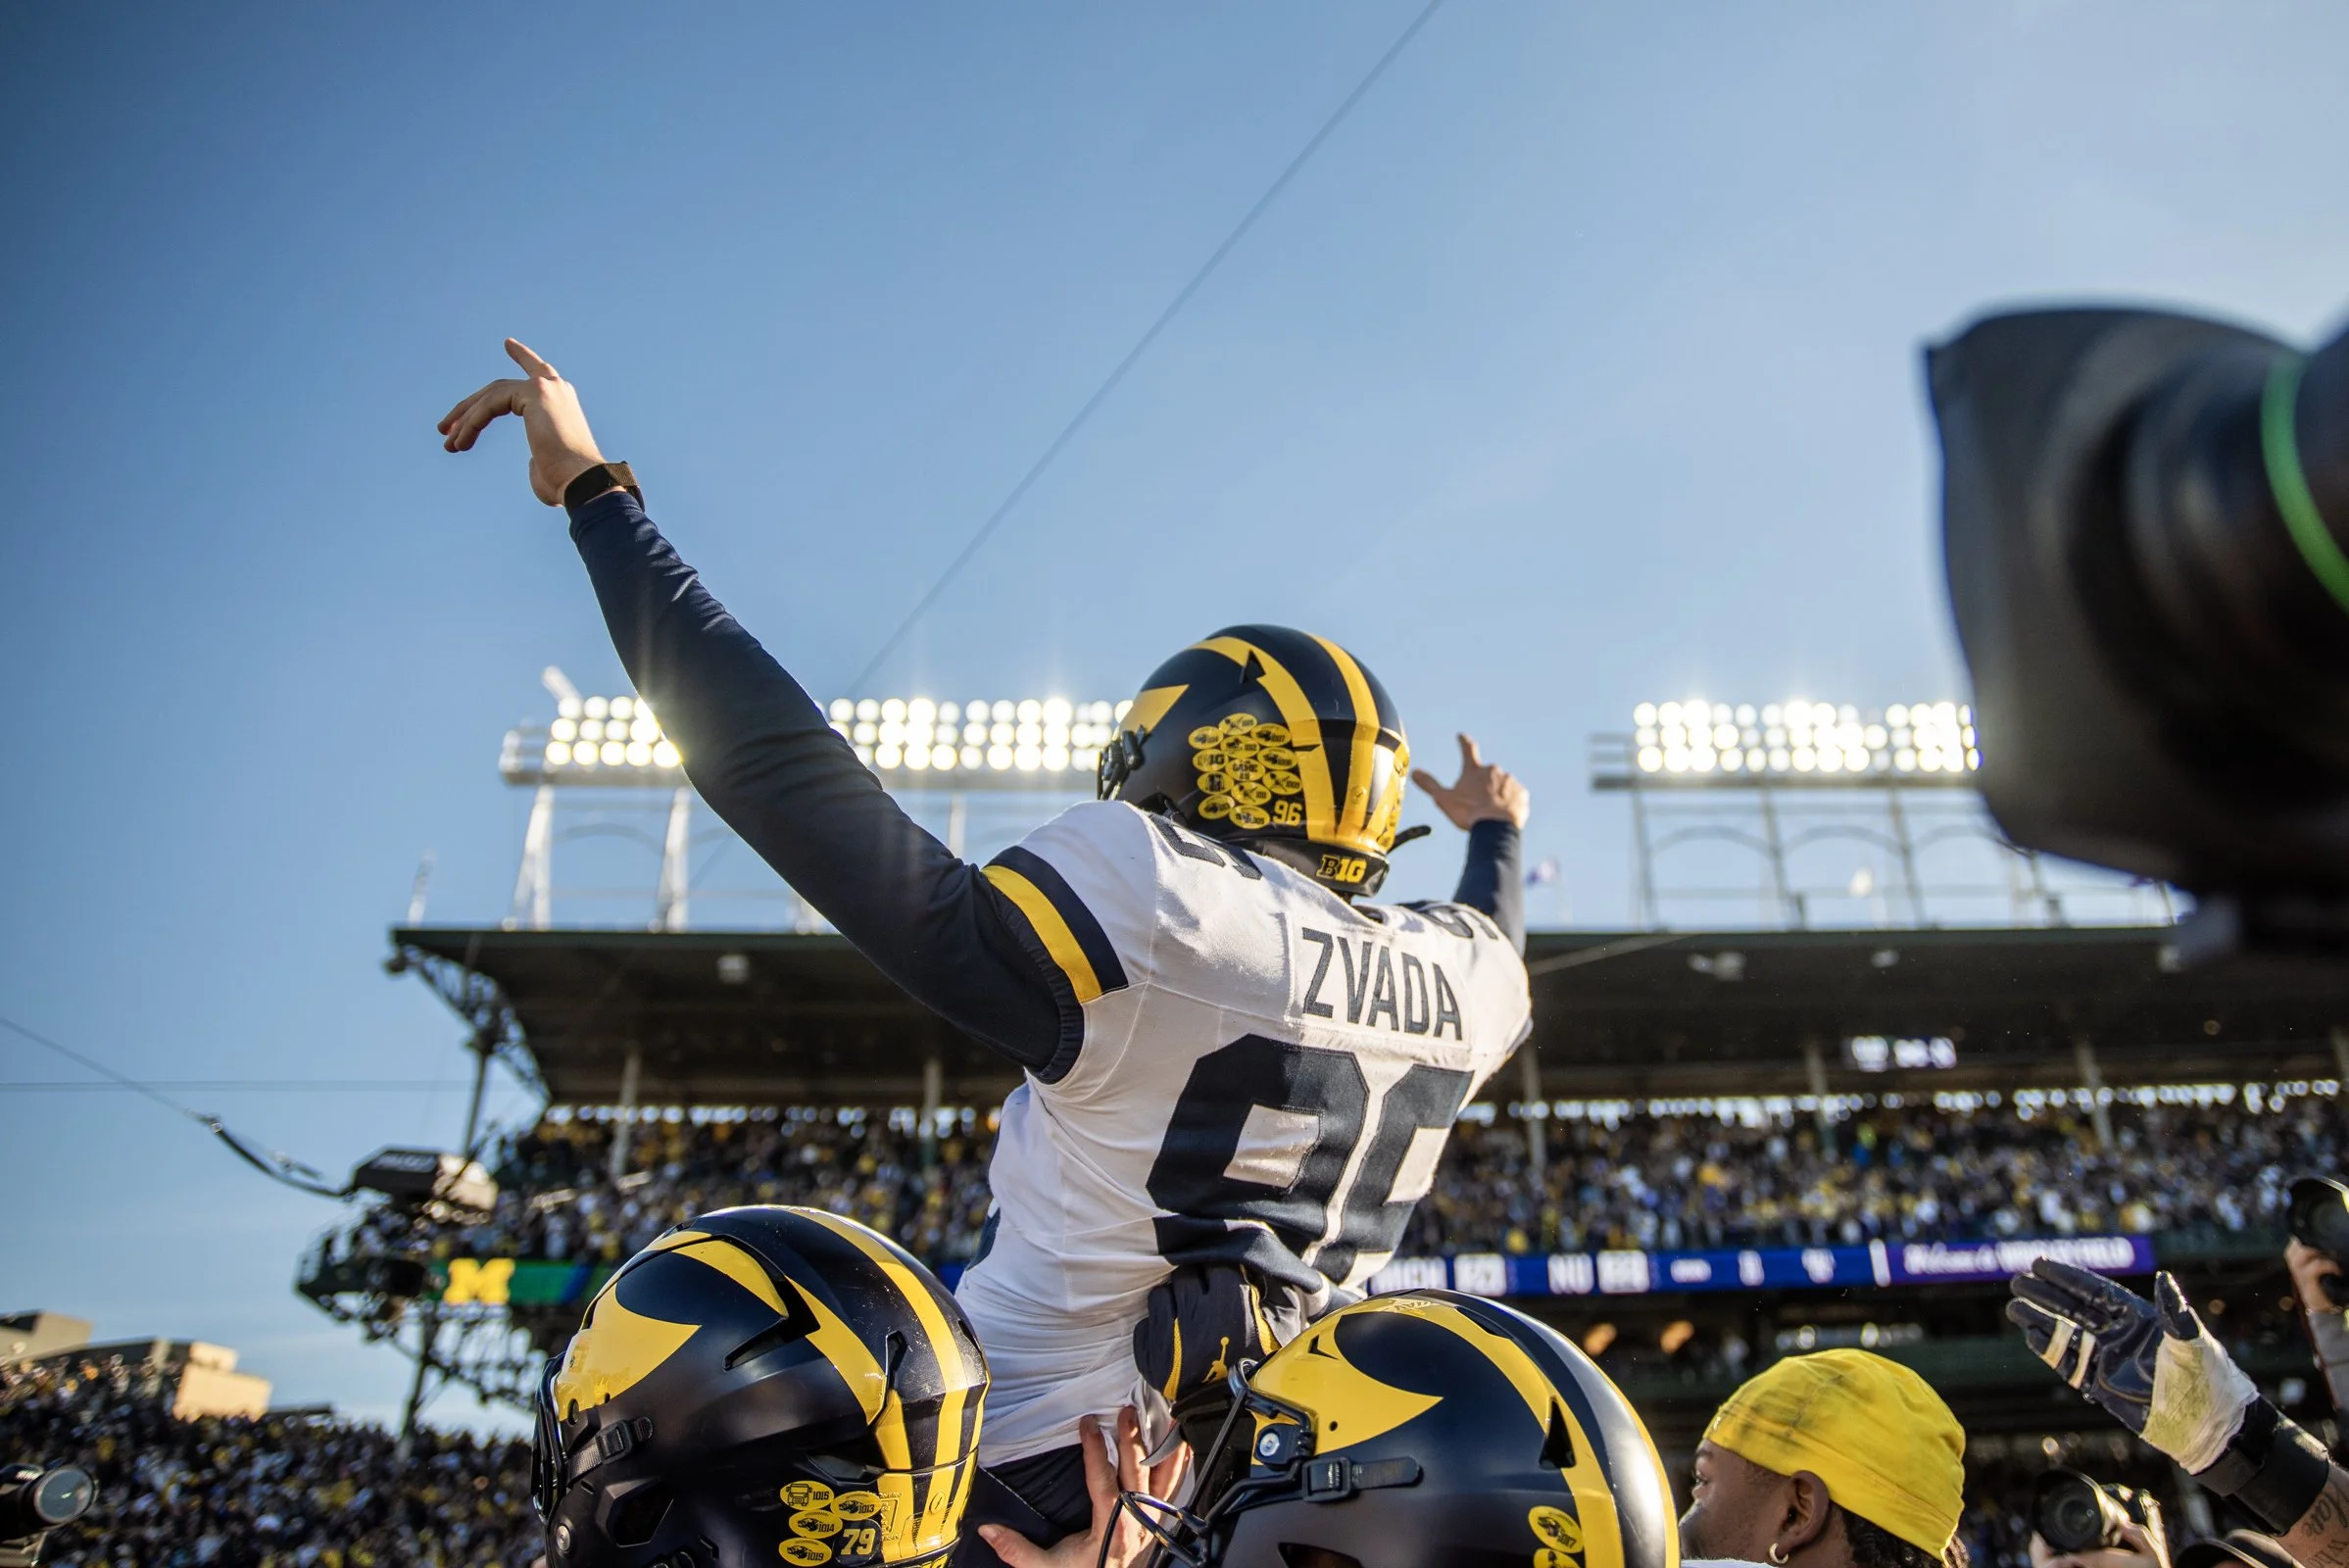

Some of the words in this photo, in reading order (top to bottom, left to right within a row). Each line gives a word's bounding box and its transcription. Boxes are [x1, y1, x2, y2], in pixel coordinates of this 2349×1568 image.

[1273, 800, 1302, 827] 96
[1302, 927, 1463, 1041] ZVADA
[443, 1257, 515, 1305] M
[812, 1491, 830, 1500] 1015
[858, 1503, 875, 1514] 1013
[817, 1523, 835, 1533] 1014
[840, 1528, 876, 1555] 79
[807, 1550, 824, 1561] 1019
